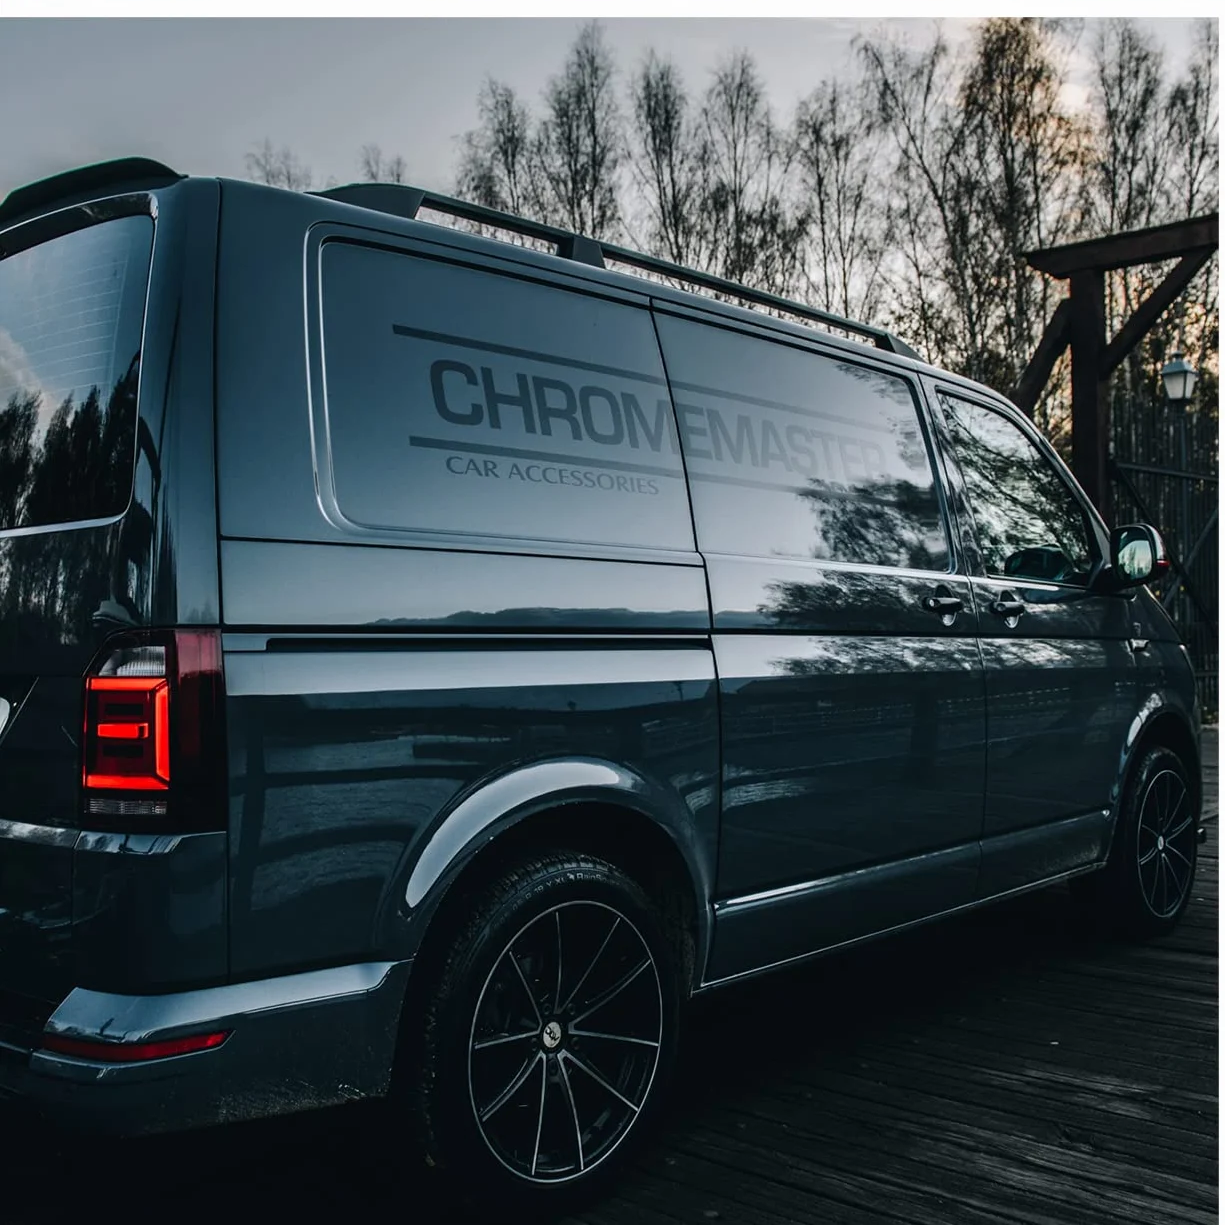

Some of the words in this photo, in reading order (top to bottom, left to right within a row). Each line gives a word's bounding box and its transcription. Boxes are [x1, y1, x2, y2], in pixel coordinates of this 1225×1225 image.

[430, 359, 887, 479] CHROMEMASTER
[446, 456, 499, 479] CAR
[508, 463, 660, 496] ACCESSORIES
